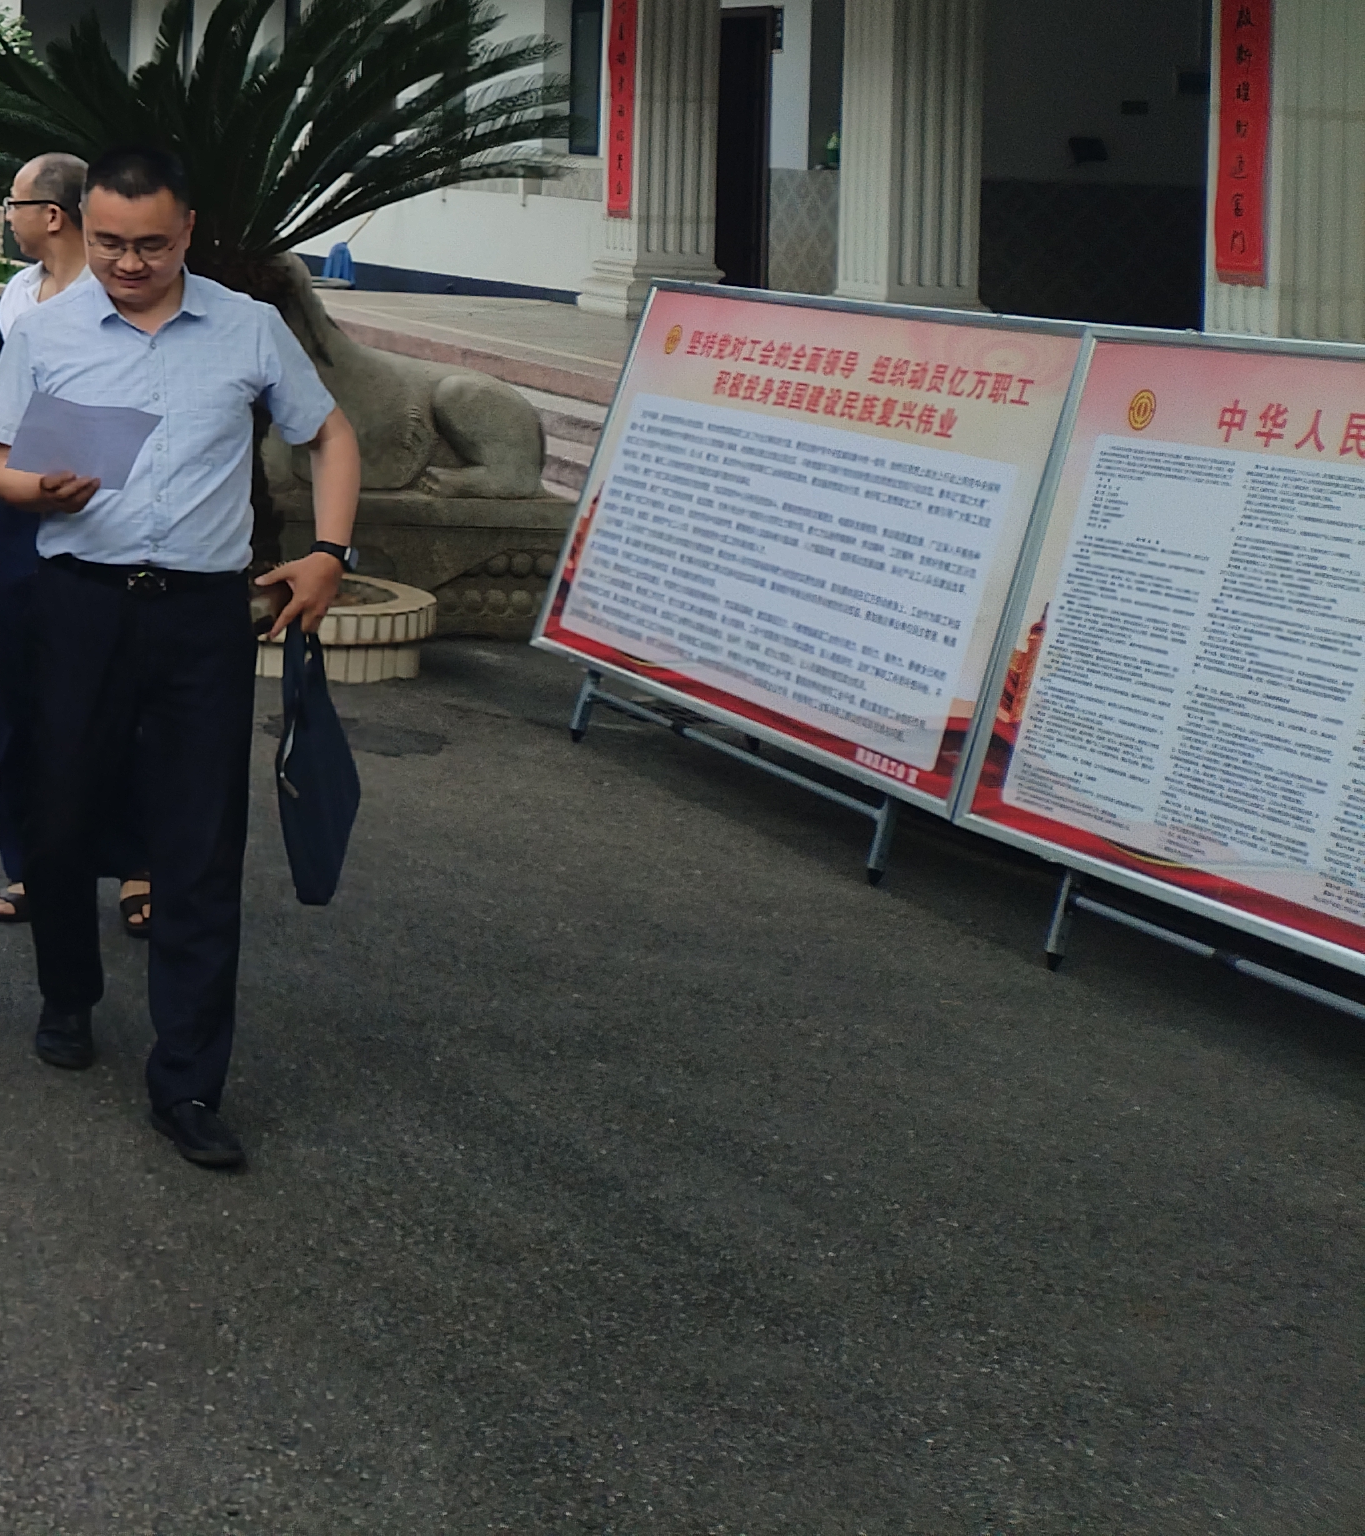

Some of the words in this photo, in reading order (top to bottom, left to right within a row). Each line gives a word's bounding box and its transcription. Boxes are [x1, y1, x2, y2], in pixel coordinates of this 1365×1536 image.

[686, 330, 859, 380] 坚持党对工会的全面领导
[868, 354, 1035, 406] 组织动员亿万职工
[712, 370, 958, 439] 积极投身强国建设民族复兴伟业
[1218, 398, 1365, 459] 中华人民
